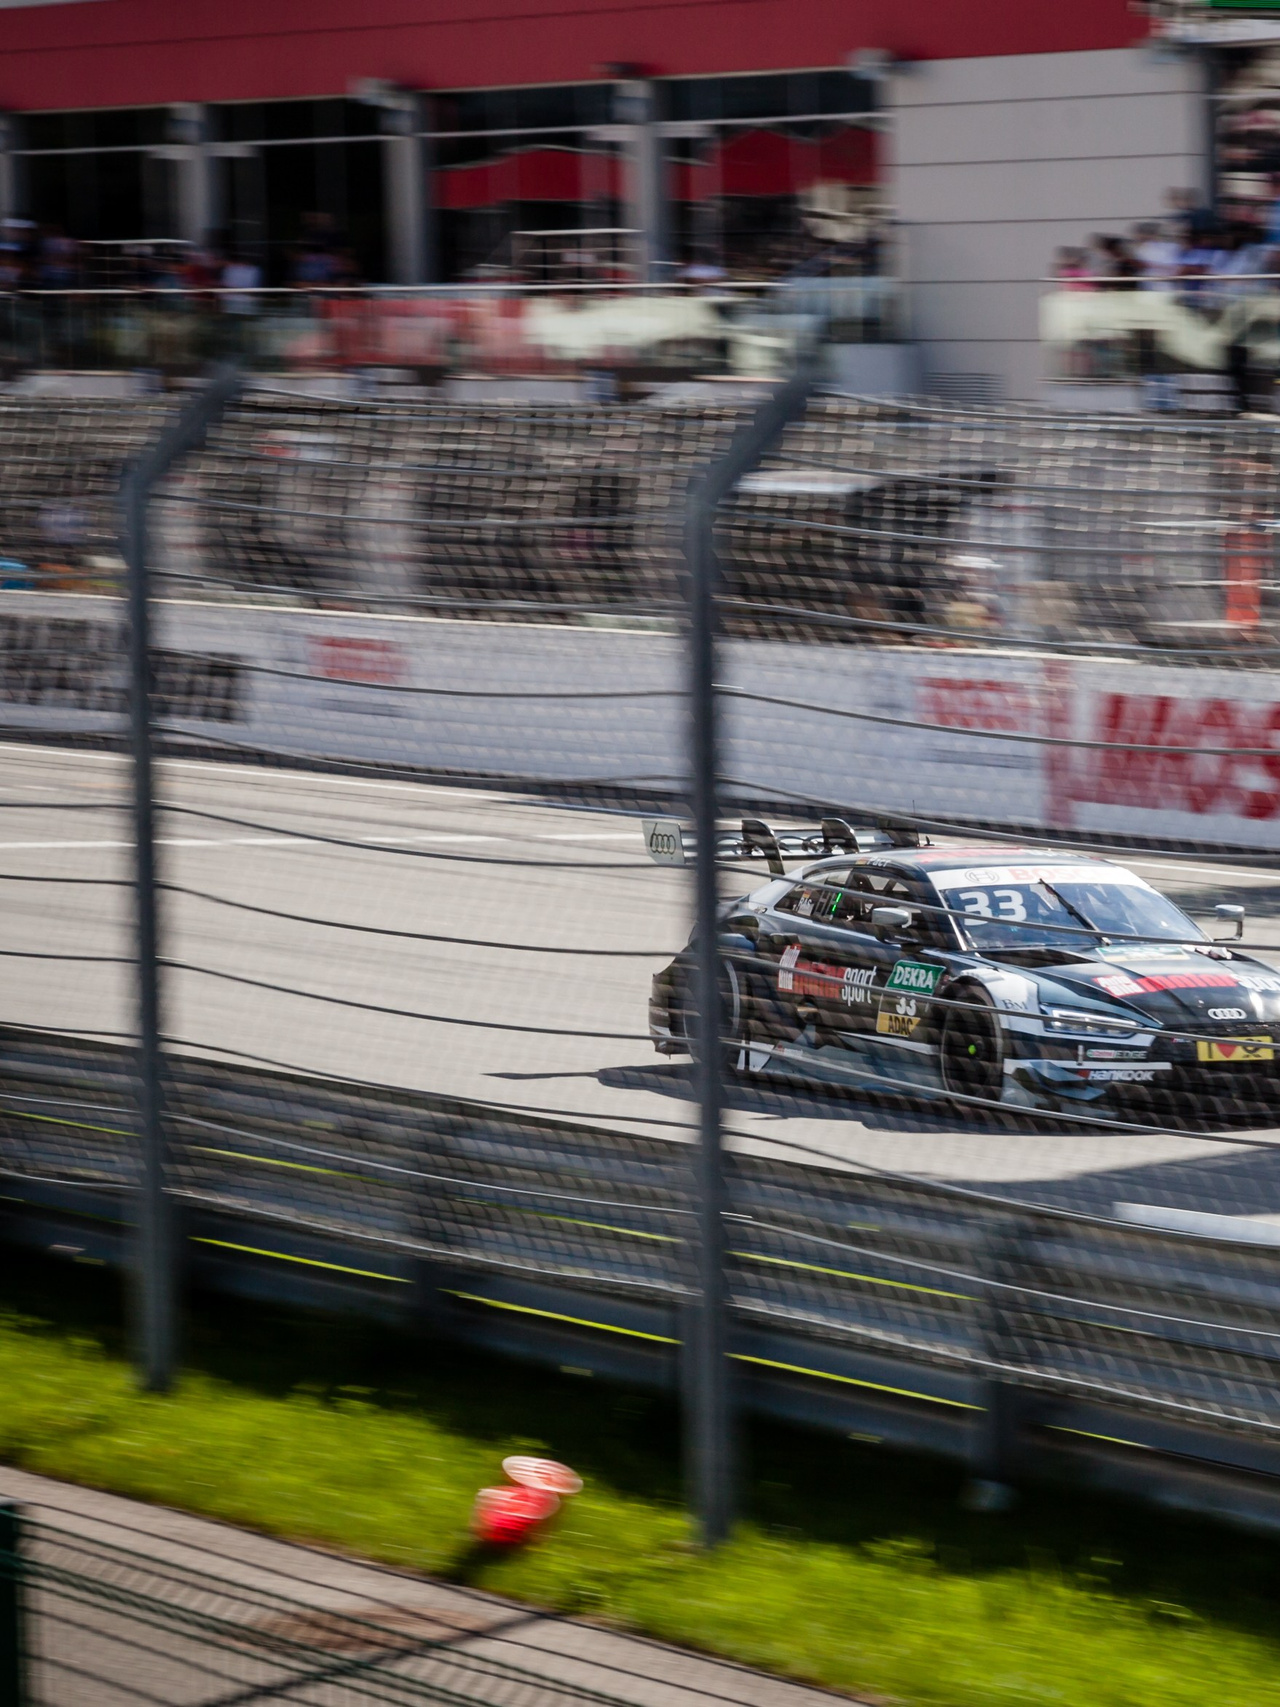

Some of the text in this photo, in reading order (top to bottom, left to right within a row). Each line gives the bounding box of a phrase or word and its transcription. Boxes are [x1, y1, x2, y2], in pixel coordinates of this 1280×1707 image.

[1008, 868, 1107, 880] BOSC
[959, 889, 1027, 926] 33
[893, 965, 934, 989] DEKRA
[888, 1015, 913, 1036] ADAC
